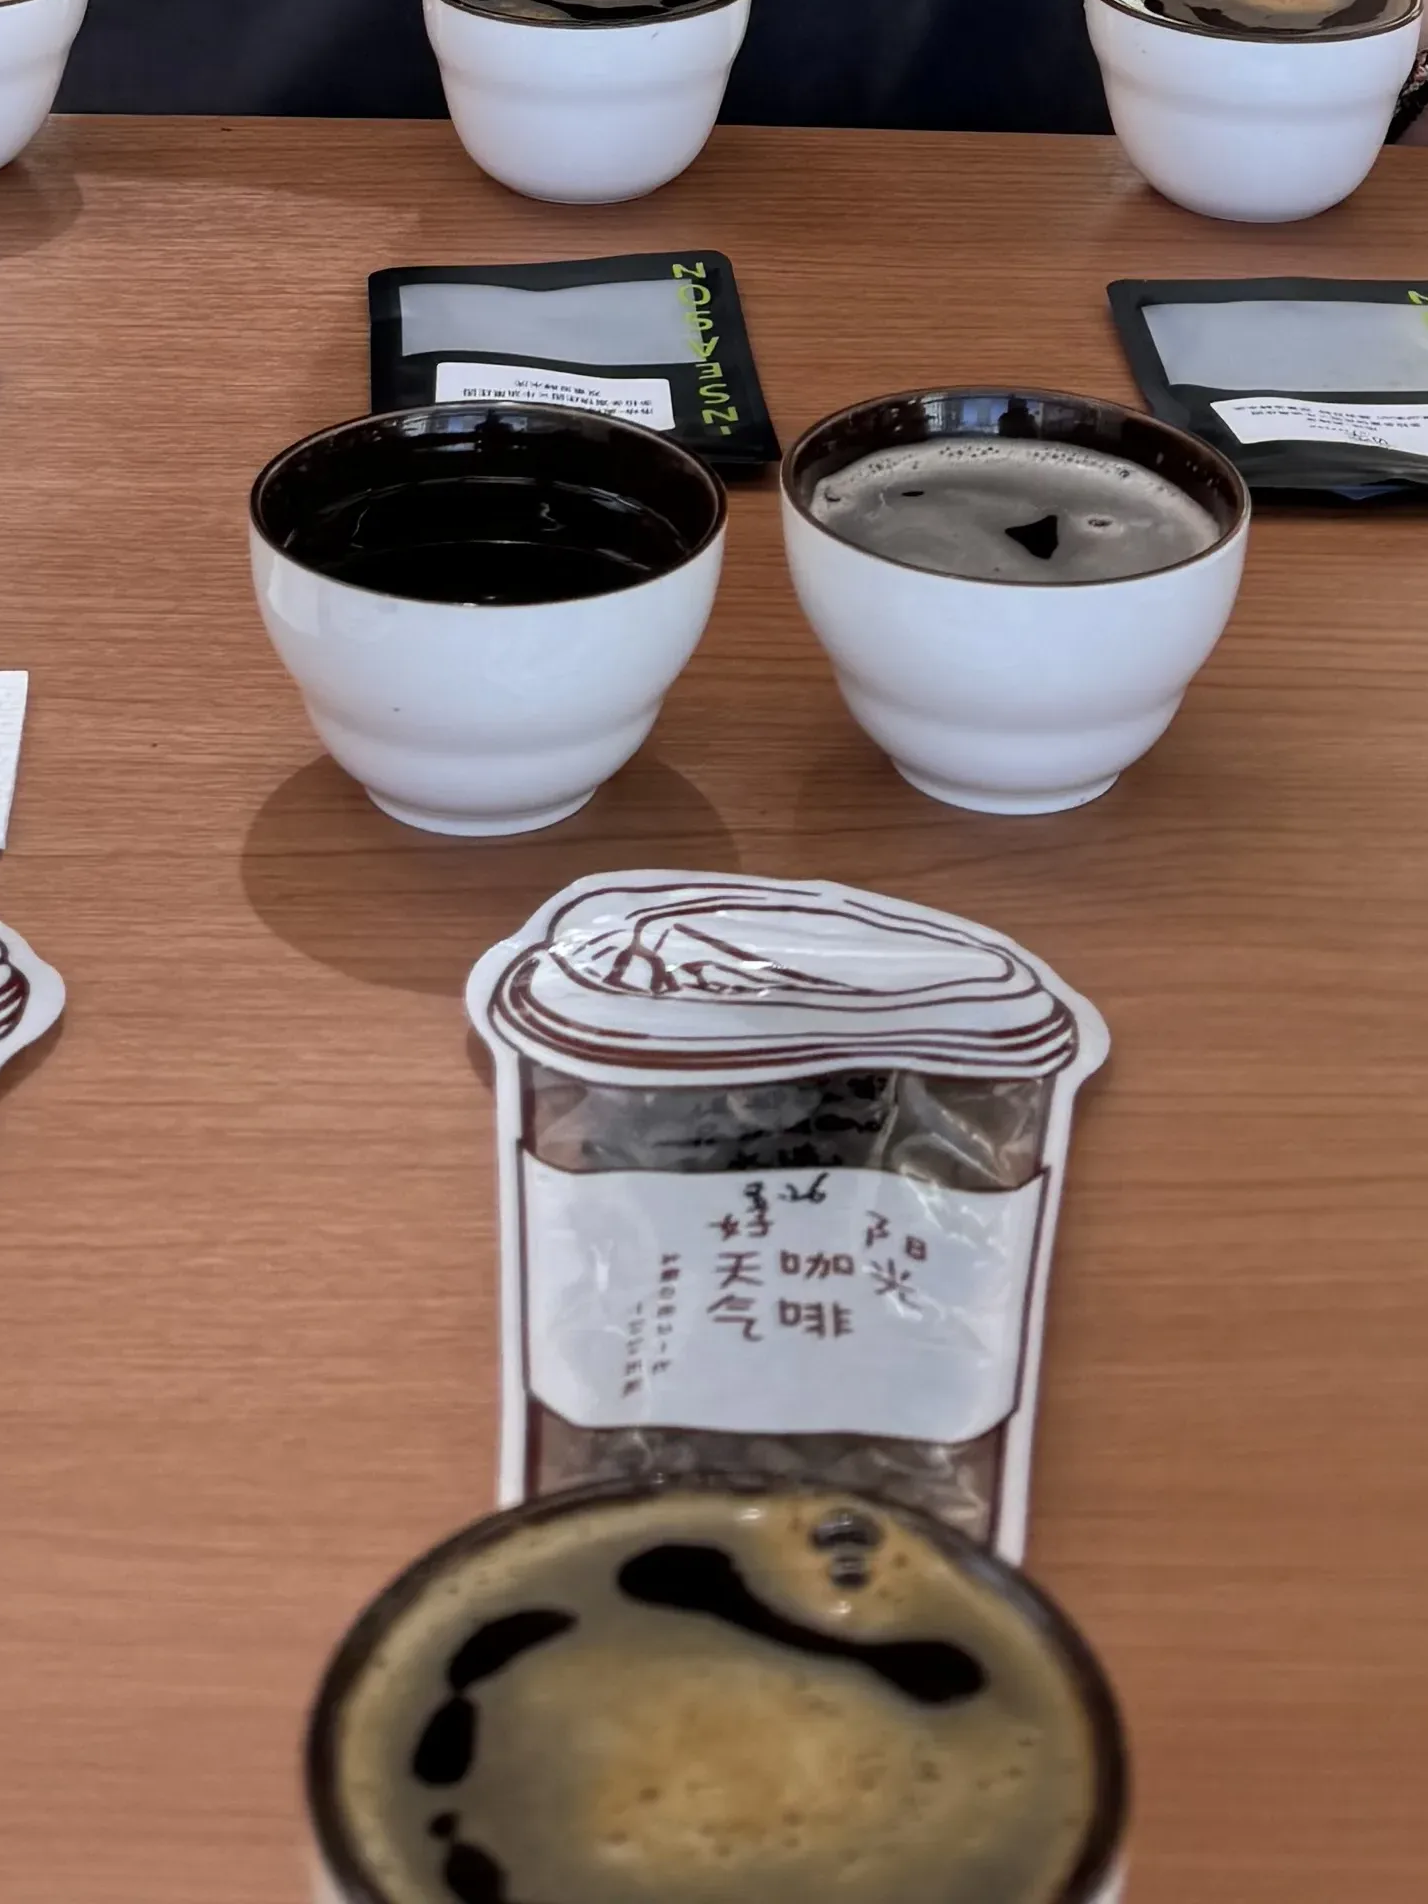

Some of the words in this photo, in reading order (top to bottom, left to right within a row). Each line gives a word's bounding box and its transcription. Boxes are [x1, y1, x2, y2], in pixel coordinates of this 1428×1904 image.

[707, 1207, 773, 1343] 好天气
[778, 1248, 856, 1340] 咖啡
[863, 1208, 928, 1311] 阳光
